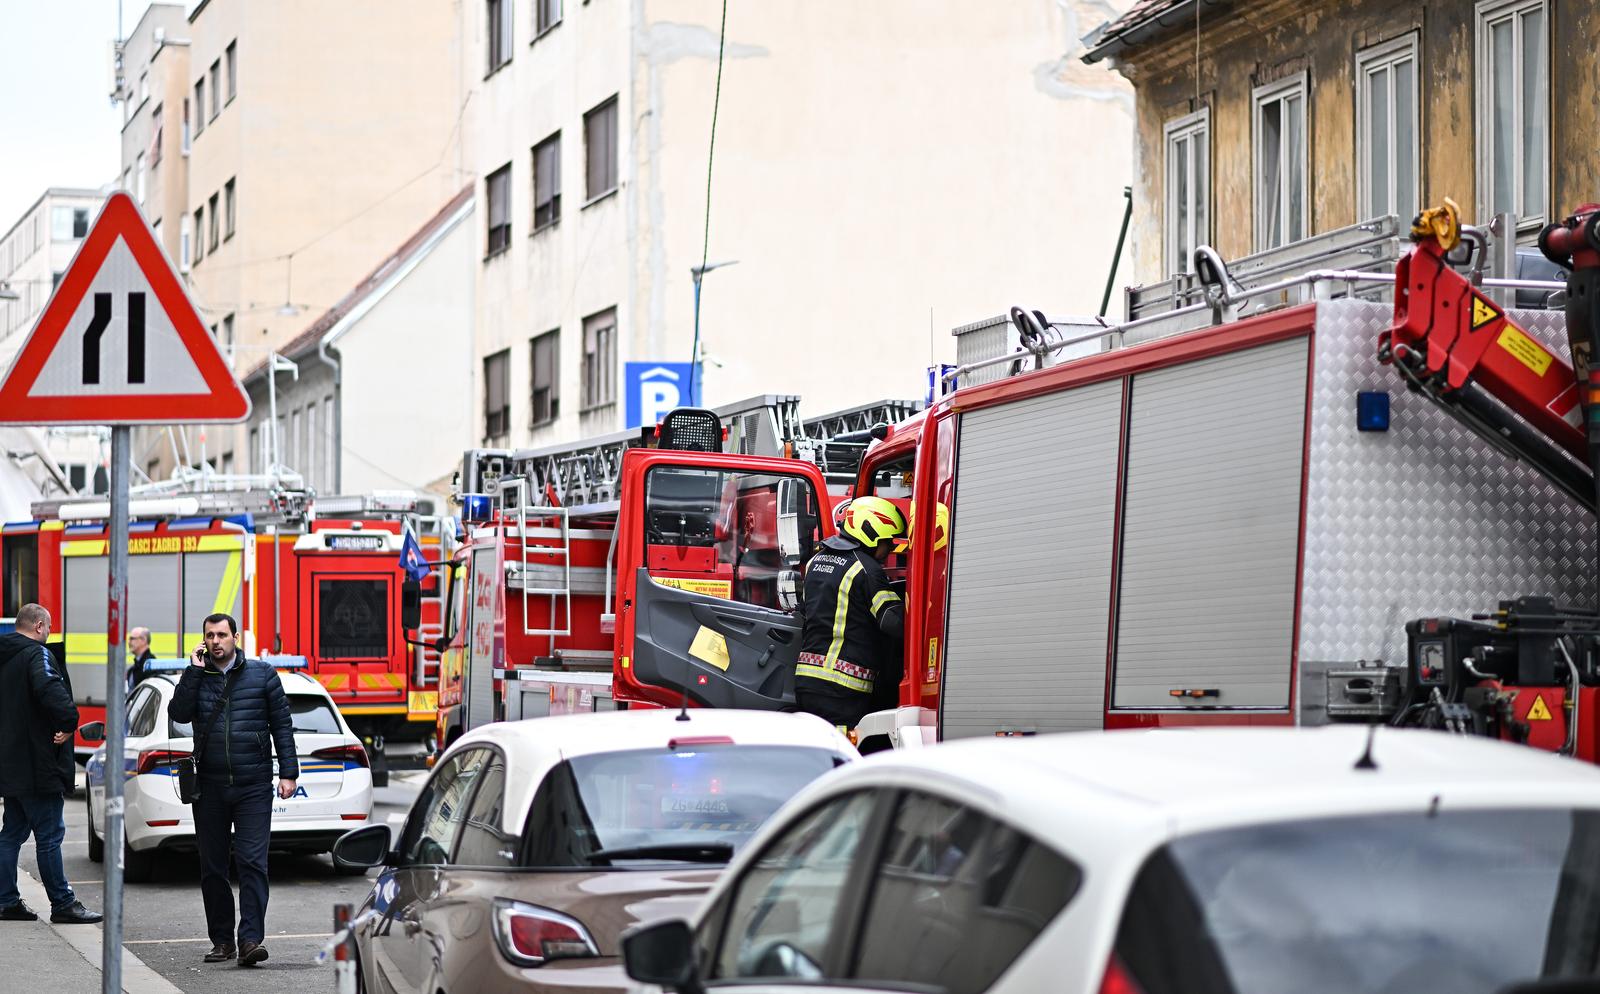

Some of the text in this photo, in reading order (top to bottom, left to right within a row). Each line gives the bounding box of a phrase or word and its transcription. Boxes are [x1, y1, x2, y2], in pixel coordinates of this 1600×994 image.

[642, 381, 680, 427] P
[152, 536, 181, 553] ZAGREB
[183, 535, 197, 551] 193
[813, 563, 835, 574] ZAGREB
